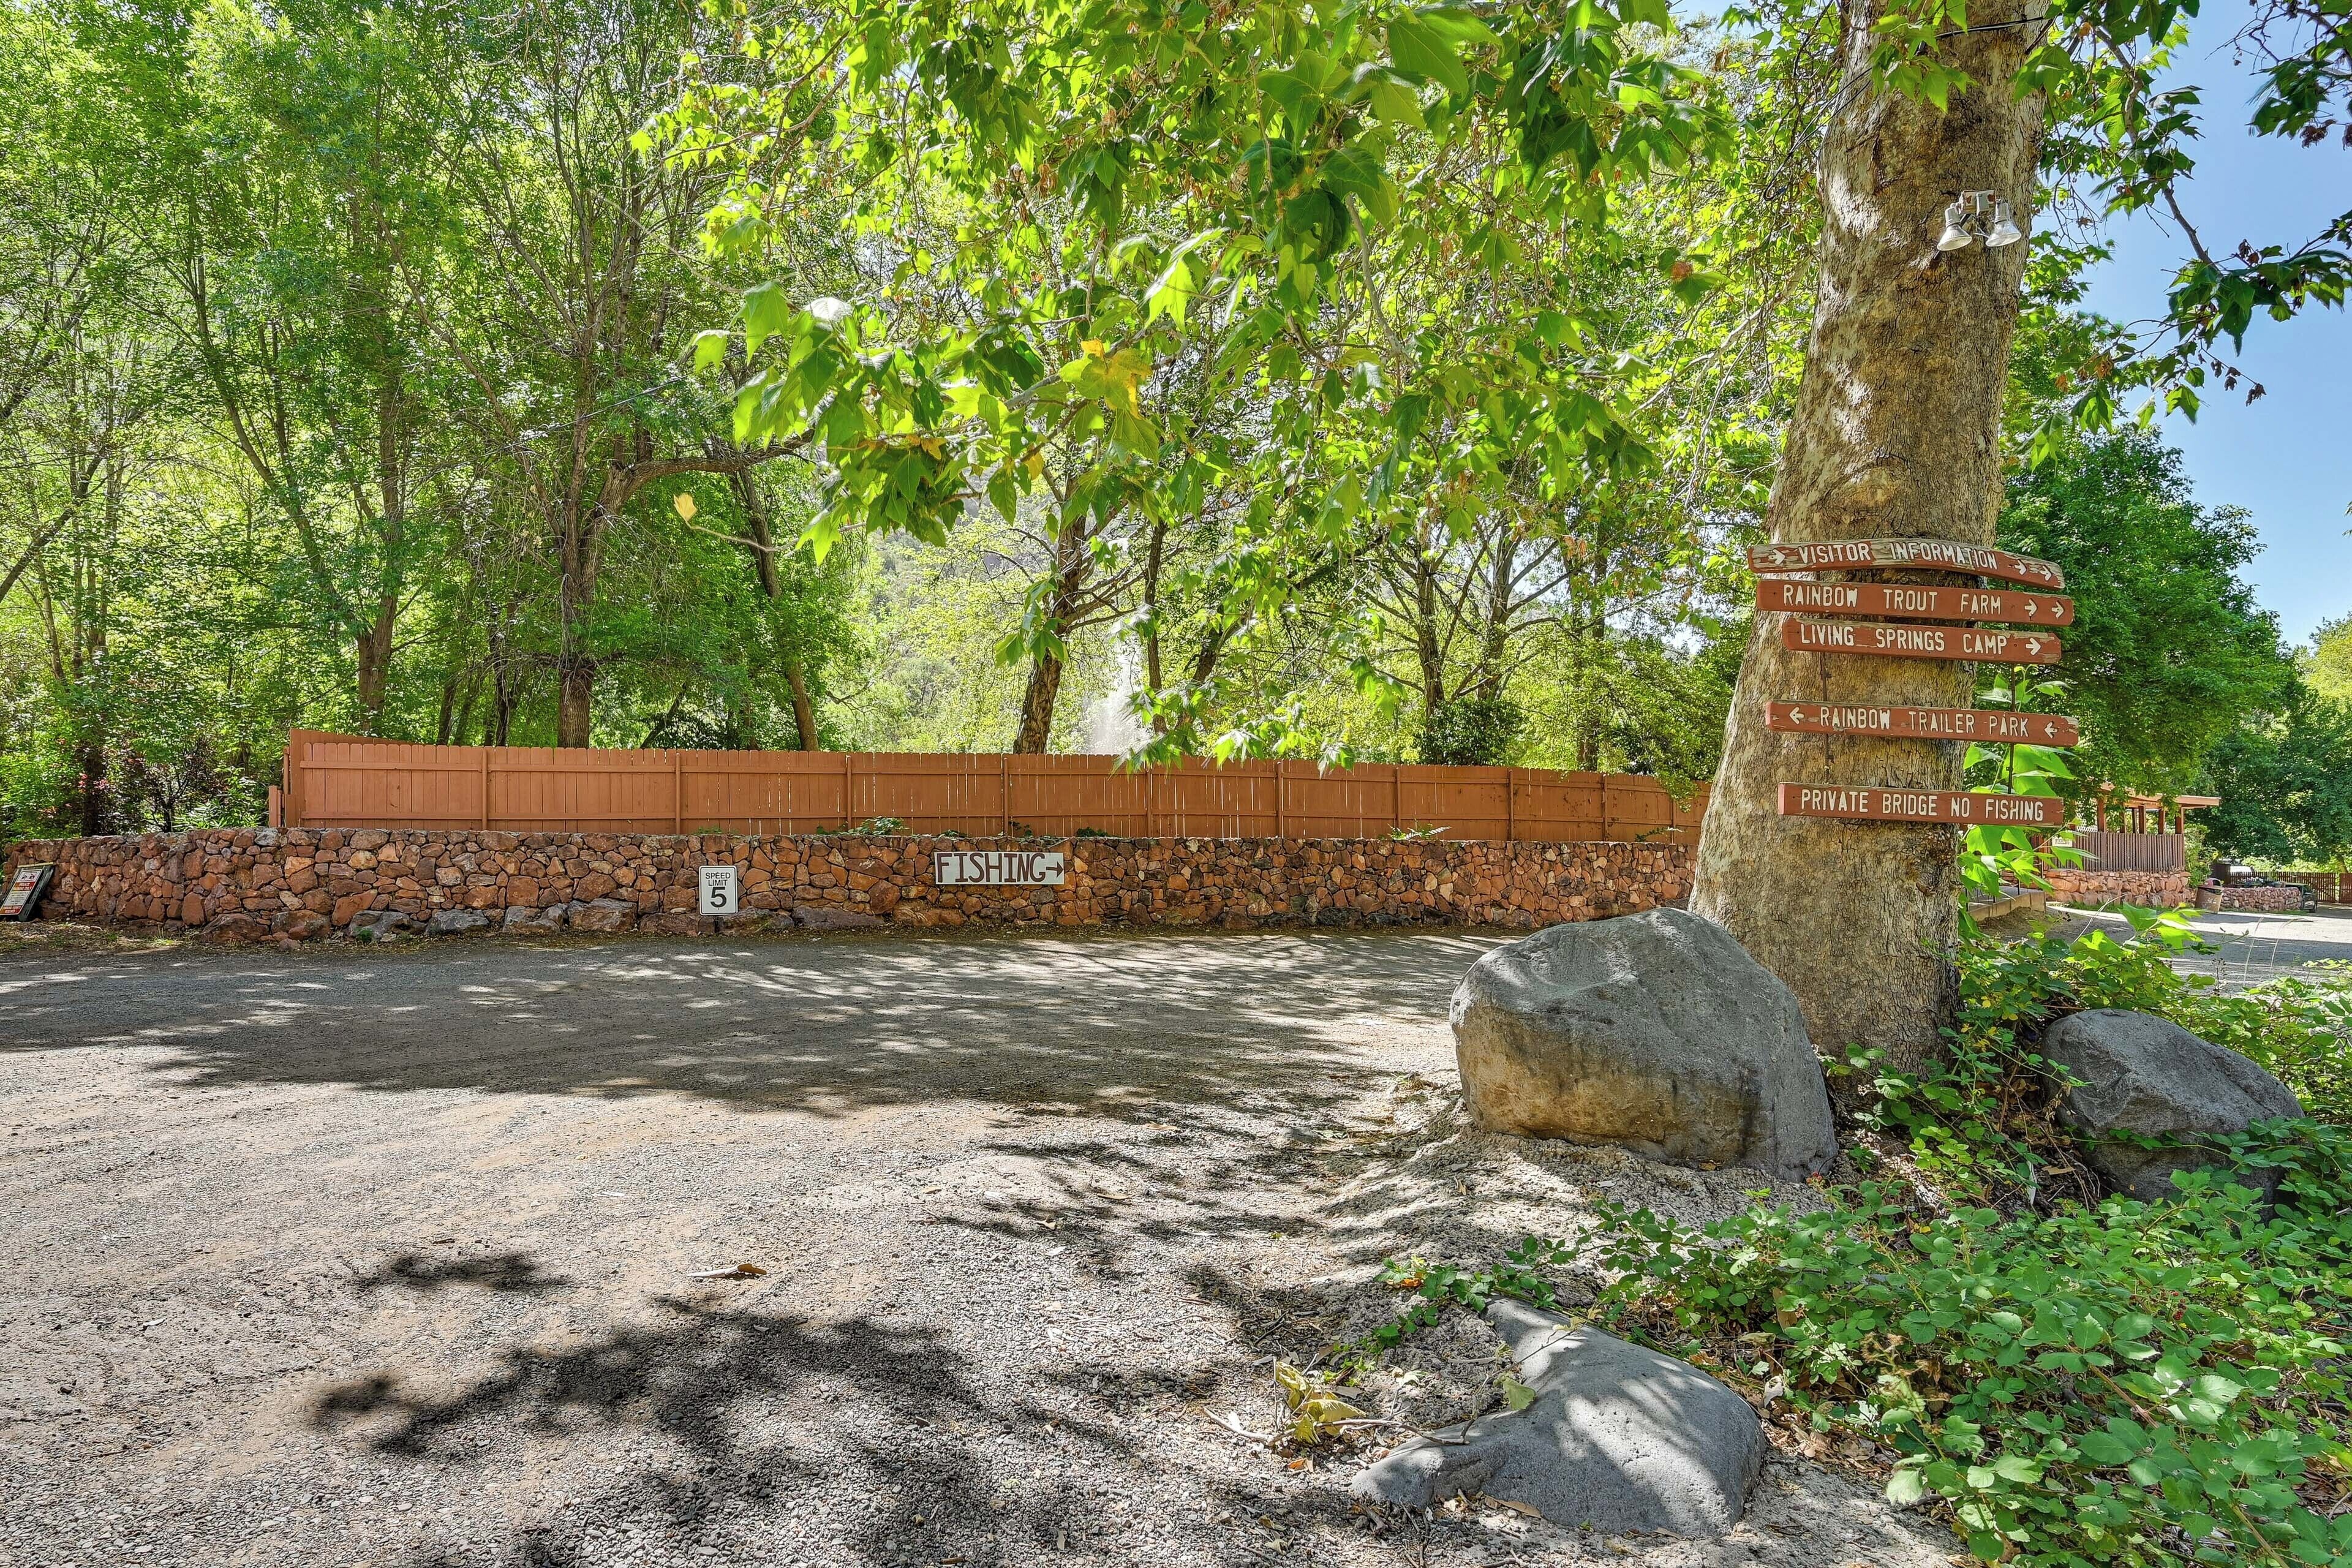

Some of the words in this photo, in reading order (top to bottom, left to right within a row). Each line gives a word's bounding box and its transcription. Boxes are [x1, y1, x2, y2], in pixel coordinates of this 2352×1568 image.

[1798, 543, 1871, 564] VISITOR
[1891, 541, 1997, 570] INFORMATION
[1784, 584, 1858, 608] RAINBOW
[1883, 589, 1938, 611] TROUT
[1961, 593, 2001, 615] FARM
[1801, 624, 1855, 646] LIVING
[1875, 628, 1945, 651] SPRINGS
[1963, 633, 2008, 655] CAMP
[1820, 706, 1891, 729] RAINBOW
[1909, 710, 1975, 734] TRAILER
[1989, 715, 2029, 737] PARK
[1801, 789, 1869, 813] PRIVATE
[1882, 793, 1937, 816] BRIDGE
[1951, 797, 1970, 818] NO
[1985, 799, 2043, 821] FISHING
[937, 853, 1046, 883] FISHING
[710, 886, 727, 908] 5
